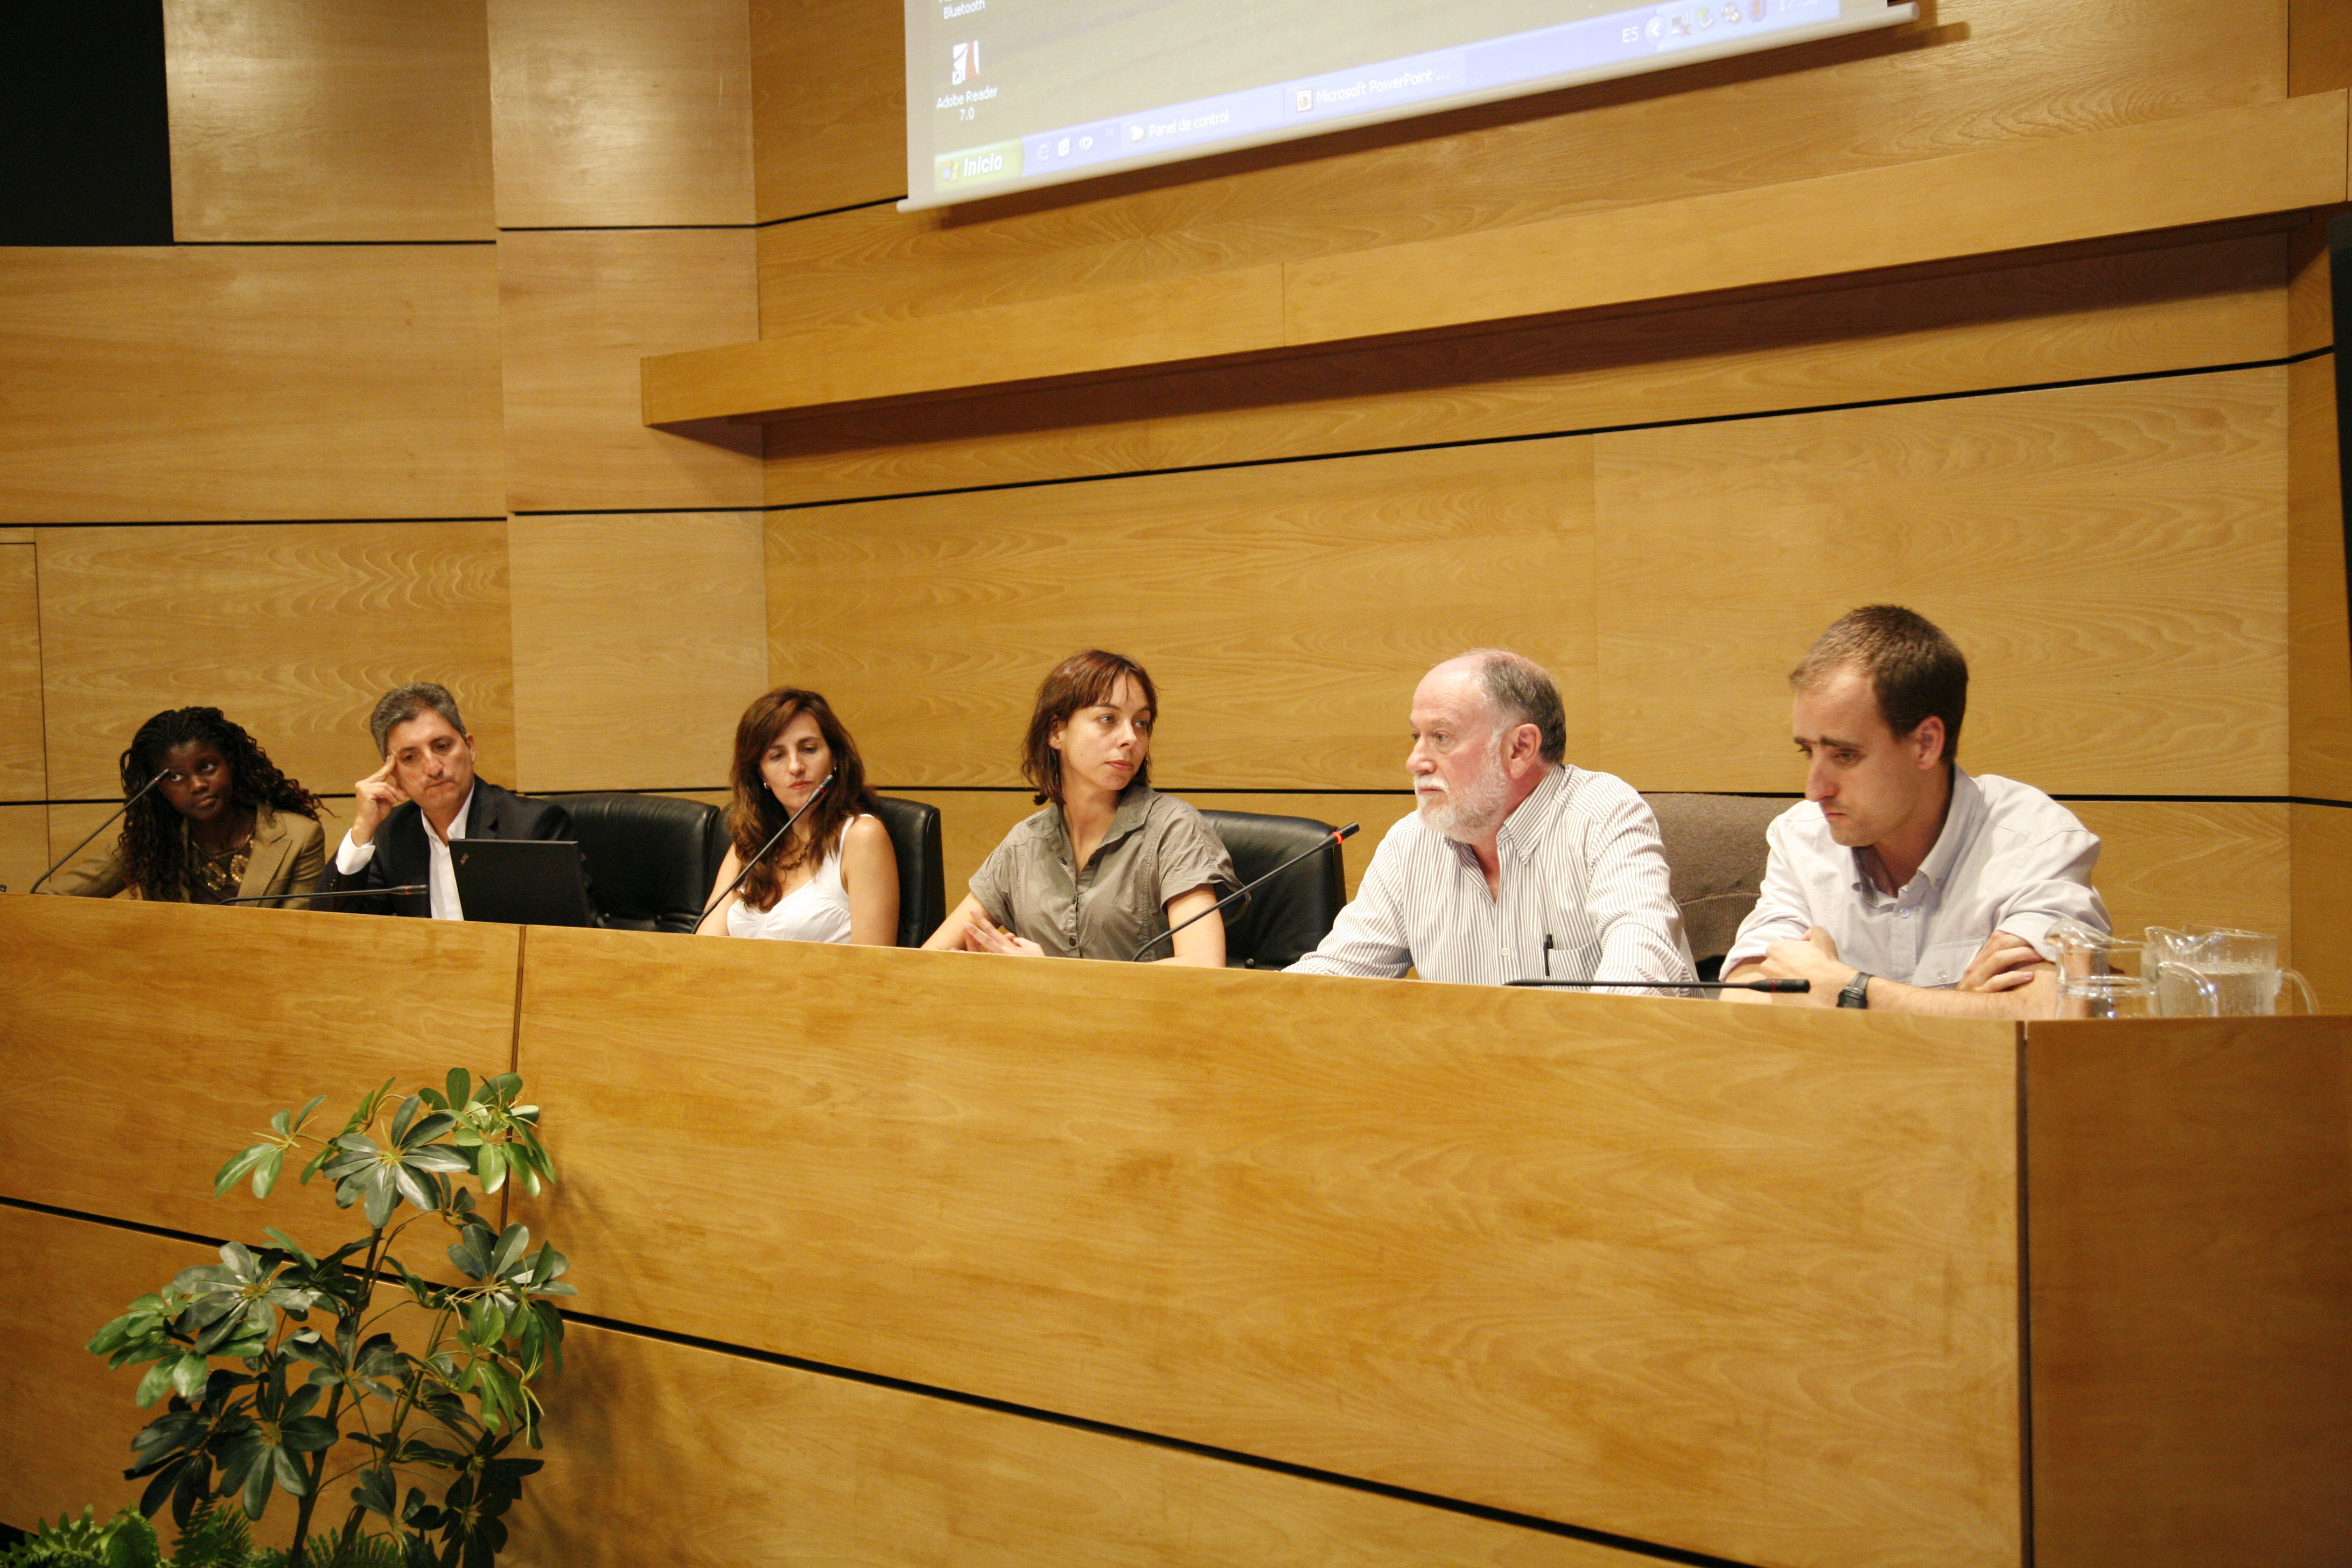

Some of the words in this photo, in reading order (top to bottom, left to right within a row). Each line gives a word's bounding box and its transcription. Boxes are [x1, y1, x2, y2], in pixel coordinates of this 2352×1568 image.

[943, 0, 985, 19] Bluetooth
[1622, 26, 1639, 43] ES
[936, 93, 965, 110] Adobe
[965, 85, 998, 103] Reader
[1316, 81, 1367, 104] Microsoft
[1369, 69, 1433, 94] PowerPoint
[959, 107, 975, 122] 7.0
[1149, 118, 1177, 137] Panel
[1178, 117, 1192, 132] de
[1194, 109, 1229, 129] control
[963, 152, 1003, 177] Inicio
